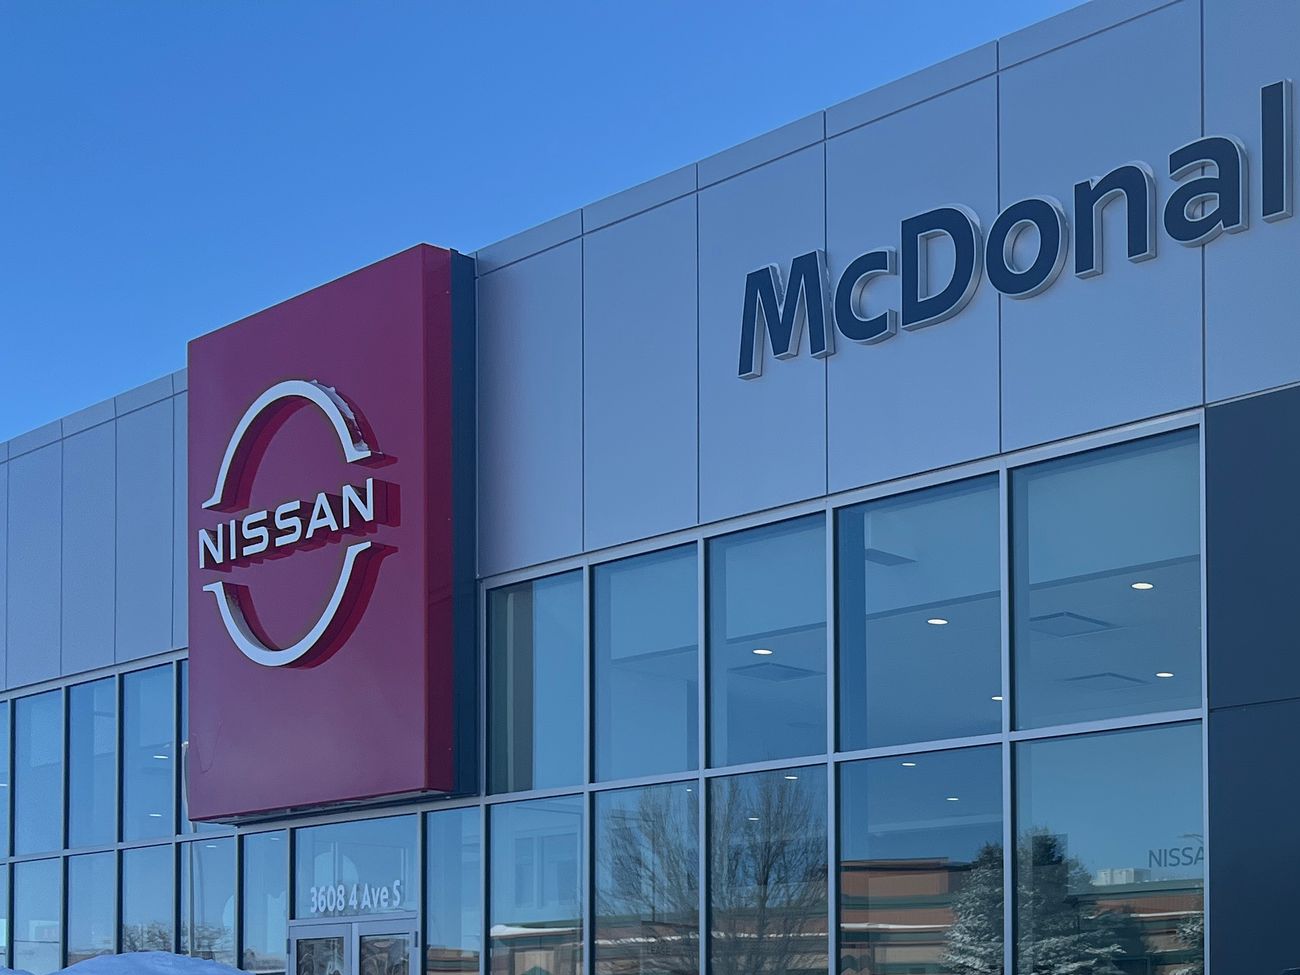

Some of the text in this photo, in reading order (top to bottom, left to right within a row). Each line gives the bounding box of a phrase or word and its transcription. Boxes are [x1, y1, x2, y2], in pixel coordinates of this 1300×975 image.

[199, 478, 374, 568] NISSAN
[1148, 846, 1204, 868] NISSA
[310, 880, 401, 913] 3608 4 Ave S
